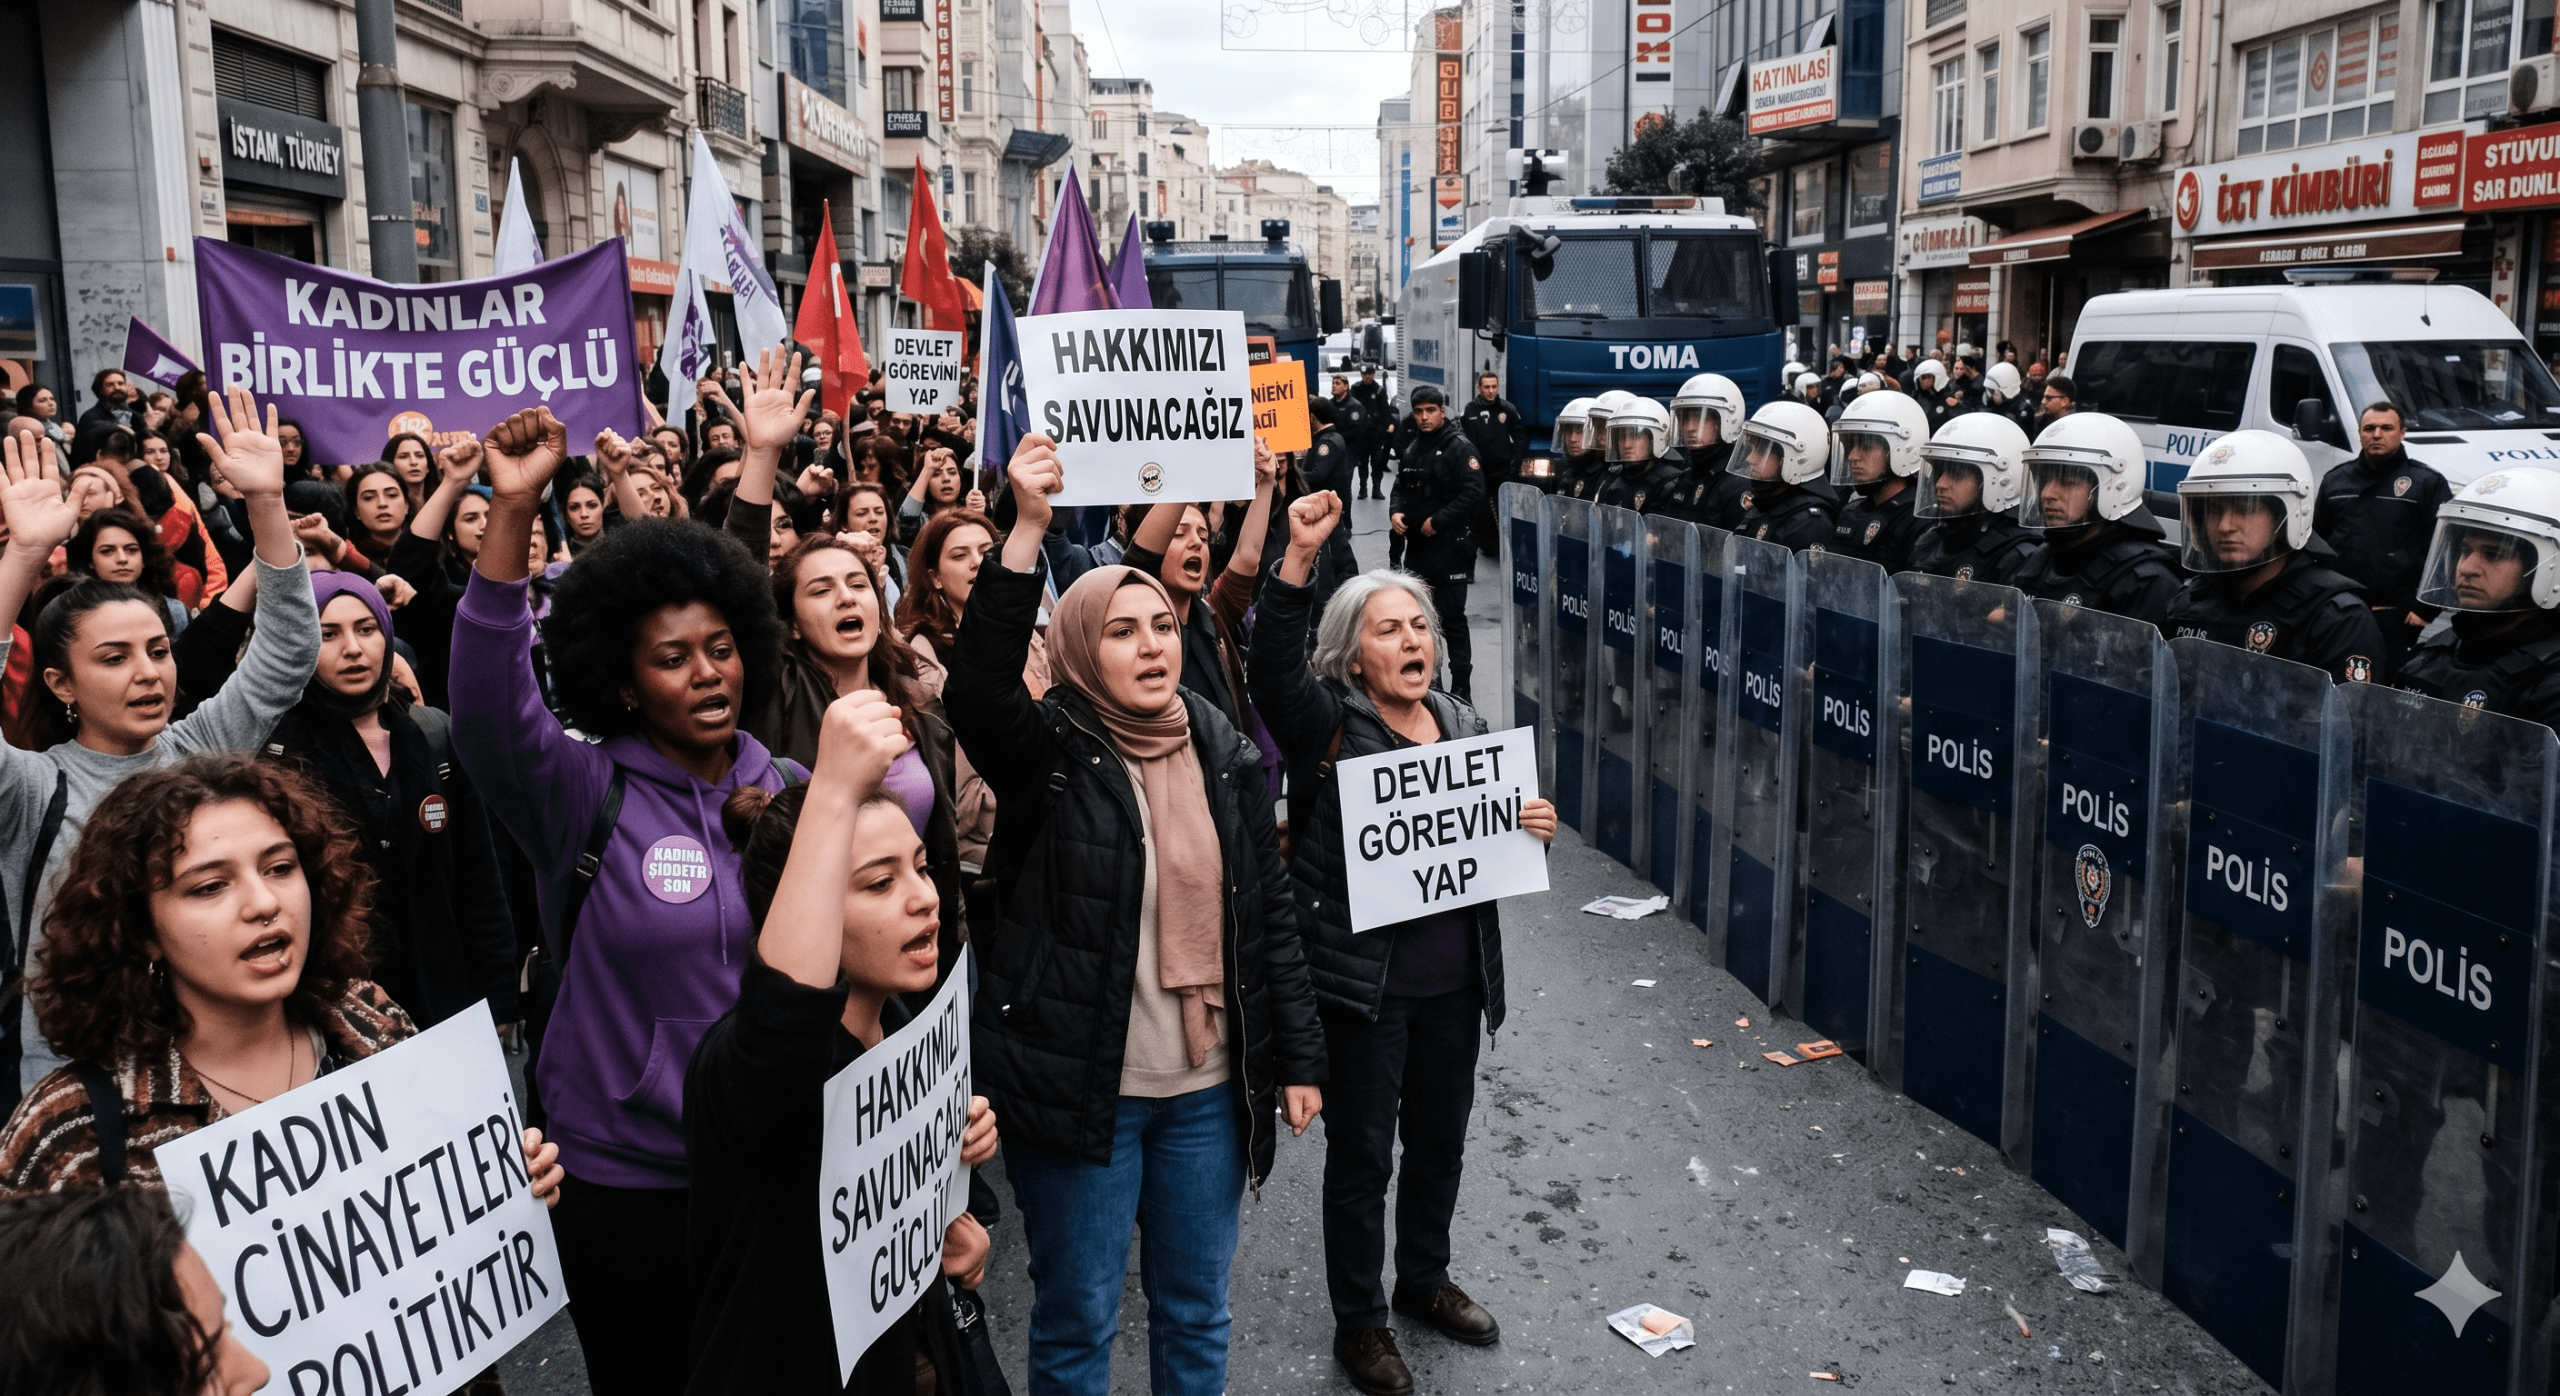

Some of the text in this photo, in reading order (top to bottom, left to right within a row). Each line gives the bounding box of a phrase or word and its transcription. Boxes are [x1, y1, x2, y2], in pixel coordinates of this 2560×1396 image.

[2473, 178, 2506, 203] SAR
[285, 278, 547, 332] KADINLAR
[220, 327, 618, 401] BİRLİKTE GÜÇLÜ
[888, 359, 958, 381] GÖREVİNİ
[895, 338, 953, 357] DEVLET
[1052, 328, 1226, 374] HAKKIMIZI
[1609, 345, 1700, 369] TOMA
[909, 388, 938, 405] YAP
[1044, 387, 1245, 443] SAVUNACAĞIZ
[2486, 446, 2560, 461] POLİ
[1517, 571, 1537, 593] POLİS
[1562, 594, 1588, 619] POLİS
[1609, 606, 1635, 635] POLİS
[1746, 671, 1781, 708] POLİS
[1824, 696, 1870, 737] POLİS
[1373, 745, 1504, 804] DEVLET
[1928, 734, 1993, 779] POLİS
[1359, 786, 1523, 861] GÖREVİNİ
[2062, 783, 2129, 837] POLİS
[654, 847, 704, 863] KADINA
[663, 878, 691, 893] SON
[1412, 857, 1478, 904] YAP
[2207, 845, 2288, 912] POLİS
[2384, 926, 2493, 1011] POLİS
[855, 990, 960, 1147] HAKKIMIZI
[199, 1080, 389, 1228] KADIN
[234, 1091, 533, 1338] CİNAYETLERİ
